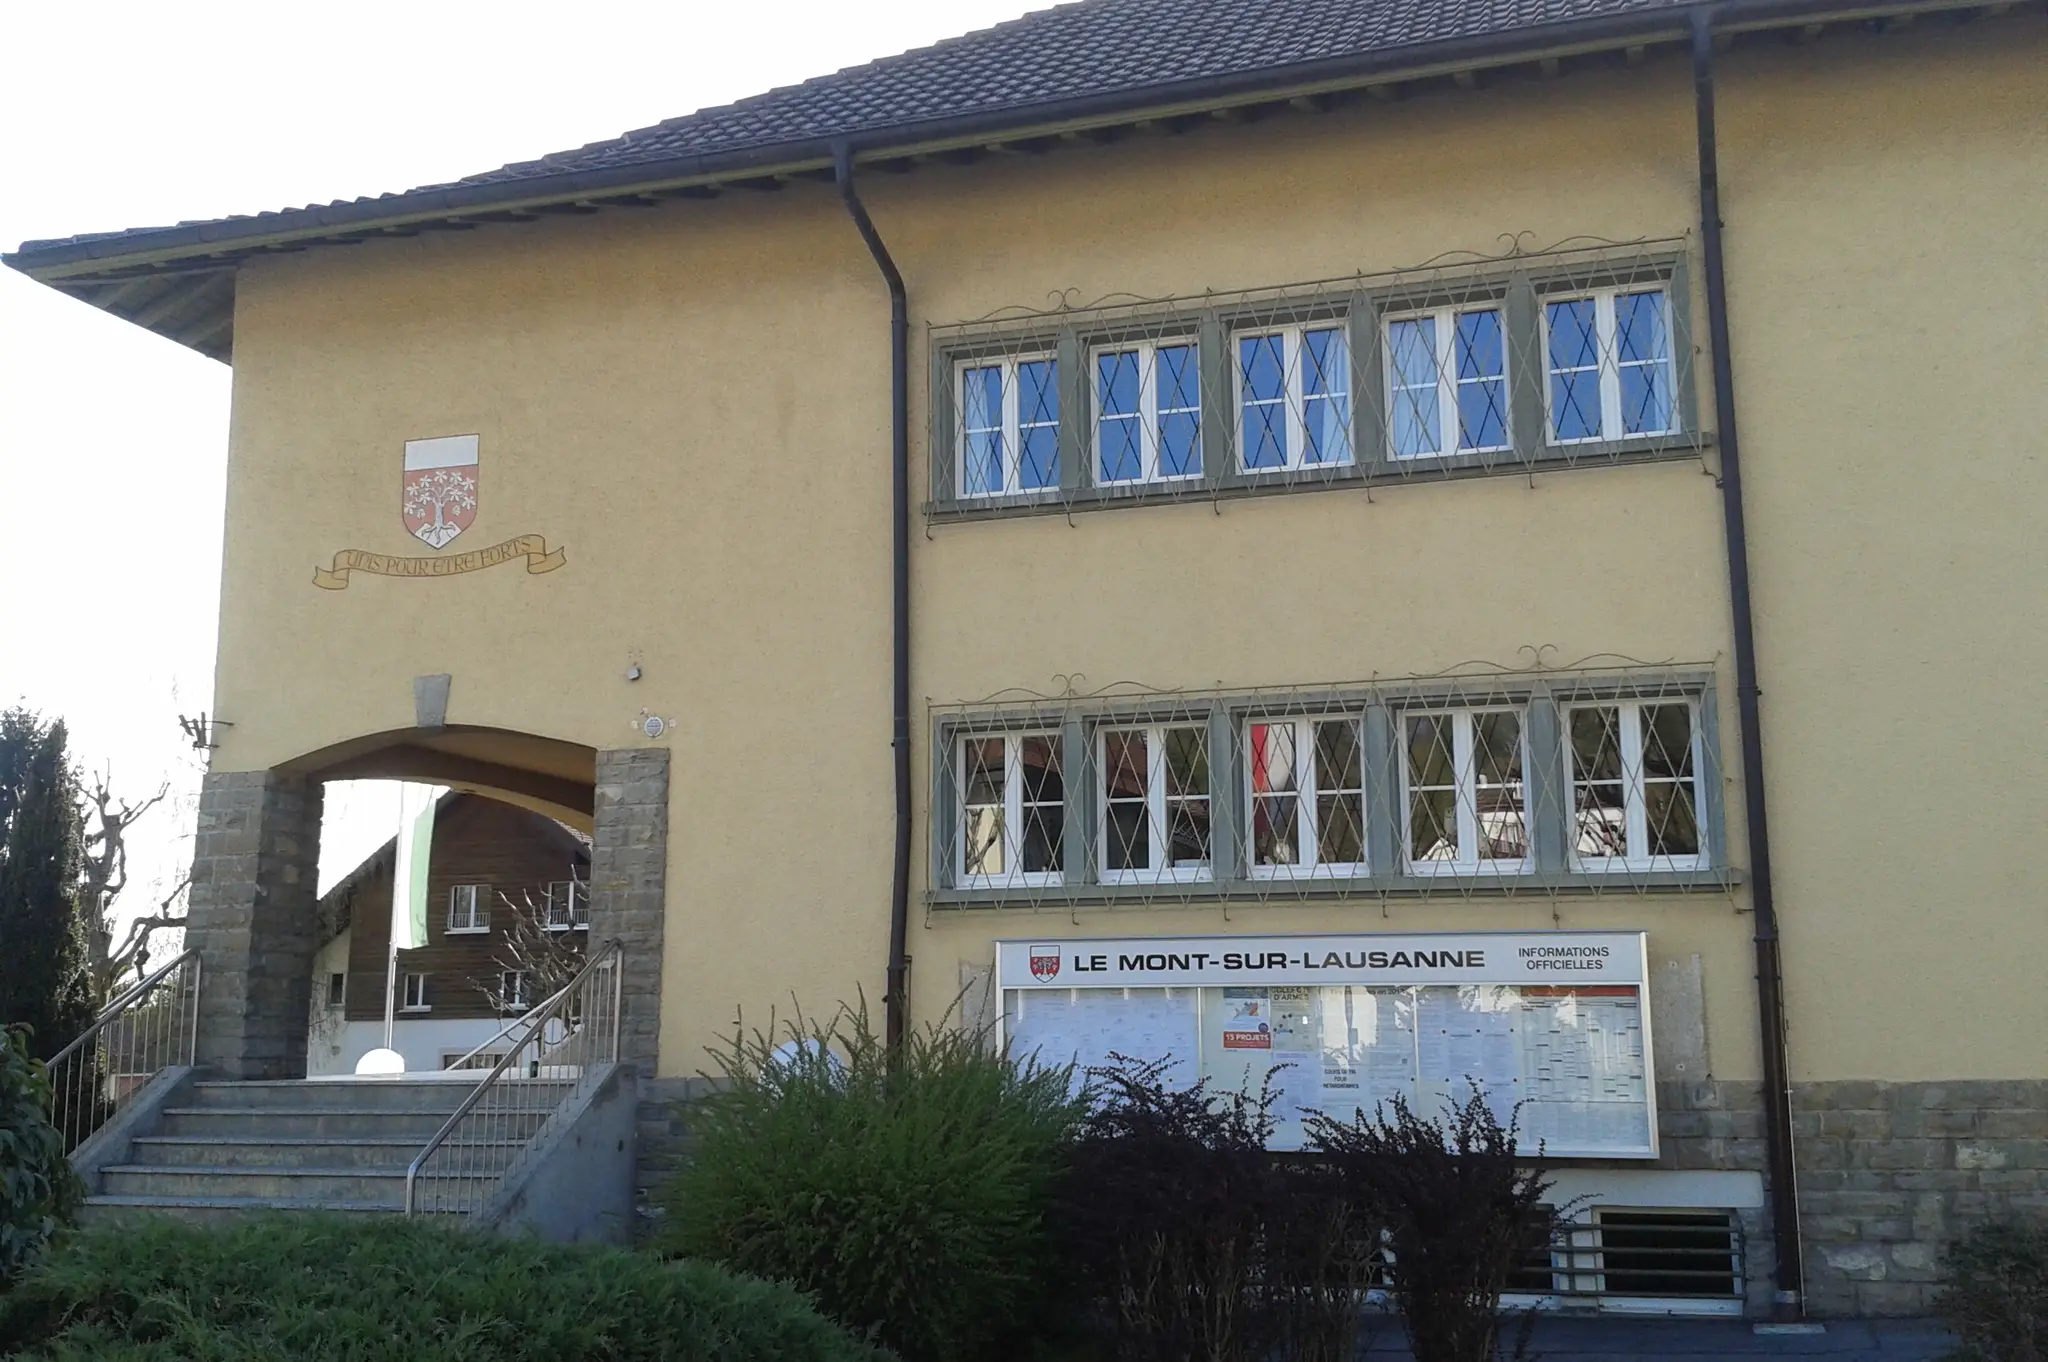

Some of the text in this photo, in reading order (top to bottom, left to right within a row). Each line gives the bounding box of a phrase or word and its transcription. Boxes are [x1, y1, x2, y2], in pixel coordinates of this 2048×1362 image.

[347, 537, 531, 574] UNIS POUR ETRE FORTS
[1518, 946, 1610, 958] INFORMATIONS
[1074, 950, 1486, 972] LE MONT-SUR-LAUSANNE
[1526, 959, 1604, 971] OFFICIELLES
[1236, 1033, 1270, 1041] PROJETS
